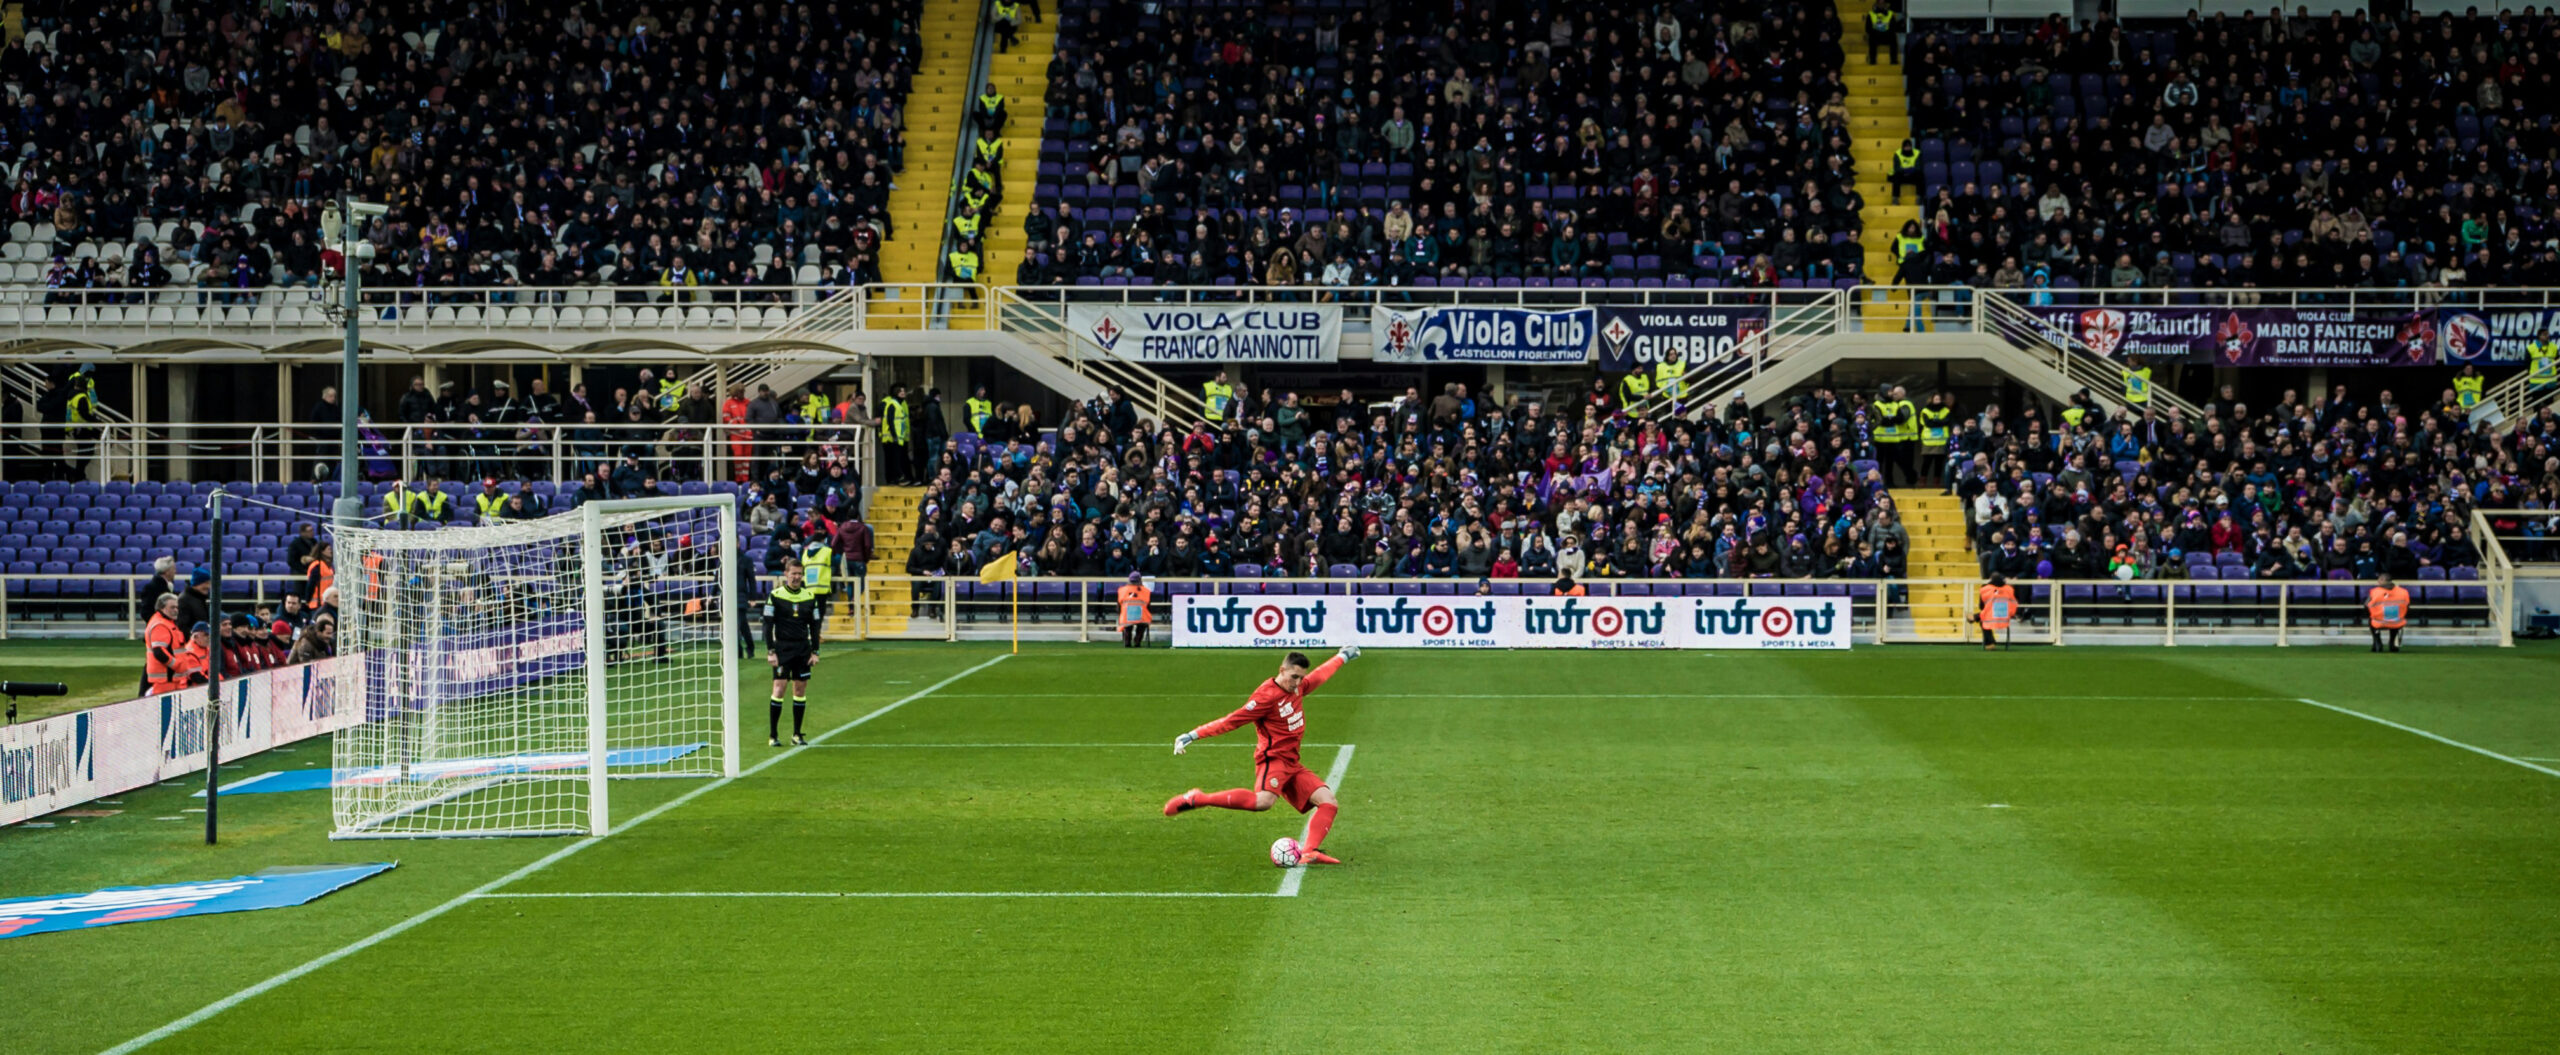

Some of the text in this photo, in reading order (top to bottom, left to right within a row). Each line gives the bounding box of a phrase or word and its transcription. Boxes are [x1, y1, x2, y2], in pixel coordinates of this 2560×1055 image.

[1144, 311, 1320, 331] VIOLA CLUB
[1640, 315, 1727, 327] VIOLA CLUB
[2128, 311, 2211, 339] Bianchi
[2297, 312, 2354, 322] VIOLA CLUB
[1448, 311, 1584, 347] Viola Club
[2257, 323, 2395, 339] MARIO FANTECHI
[1143, 335, 1320, 359] FRANCO NANNOTTI
[1453, 349, 1582, 360] CASTIGLION FIORENTINO
[1634, 335, 1734, 363] GUBBIO
[2122, 340, 2190, 355] Montuori
[2277, 339, 2373, 354] BAR MARISA
[1187, 597, 1327, 636] infront
[1356, 597, 1496, 636] infront
[1525, 598, 1665, 637] infront
[1695, 599, 1835, 637] infront
[1253, 638, 1288, 646] SPORTS
[1422, 638, 1457, 646] SPORTS
